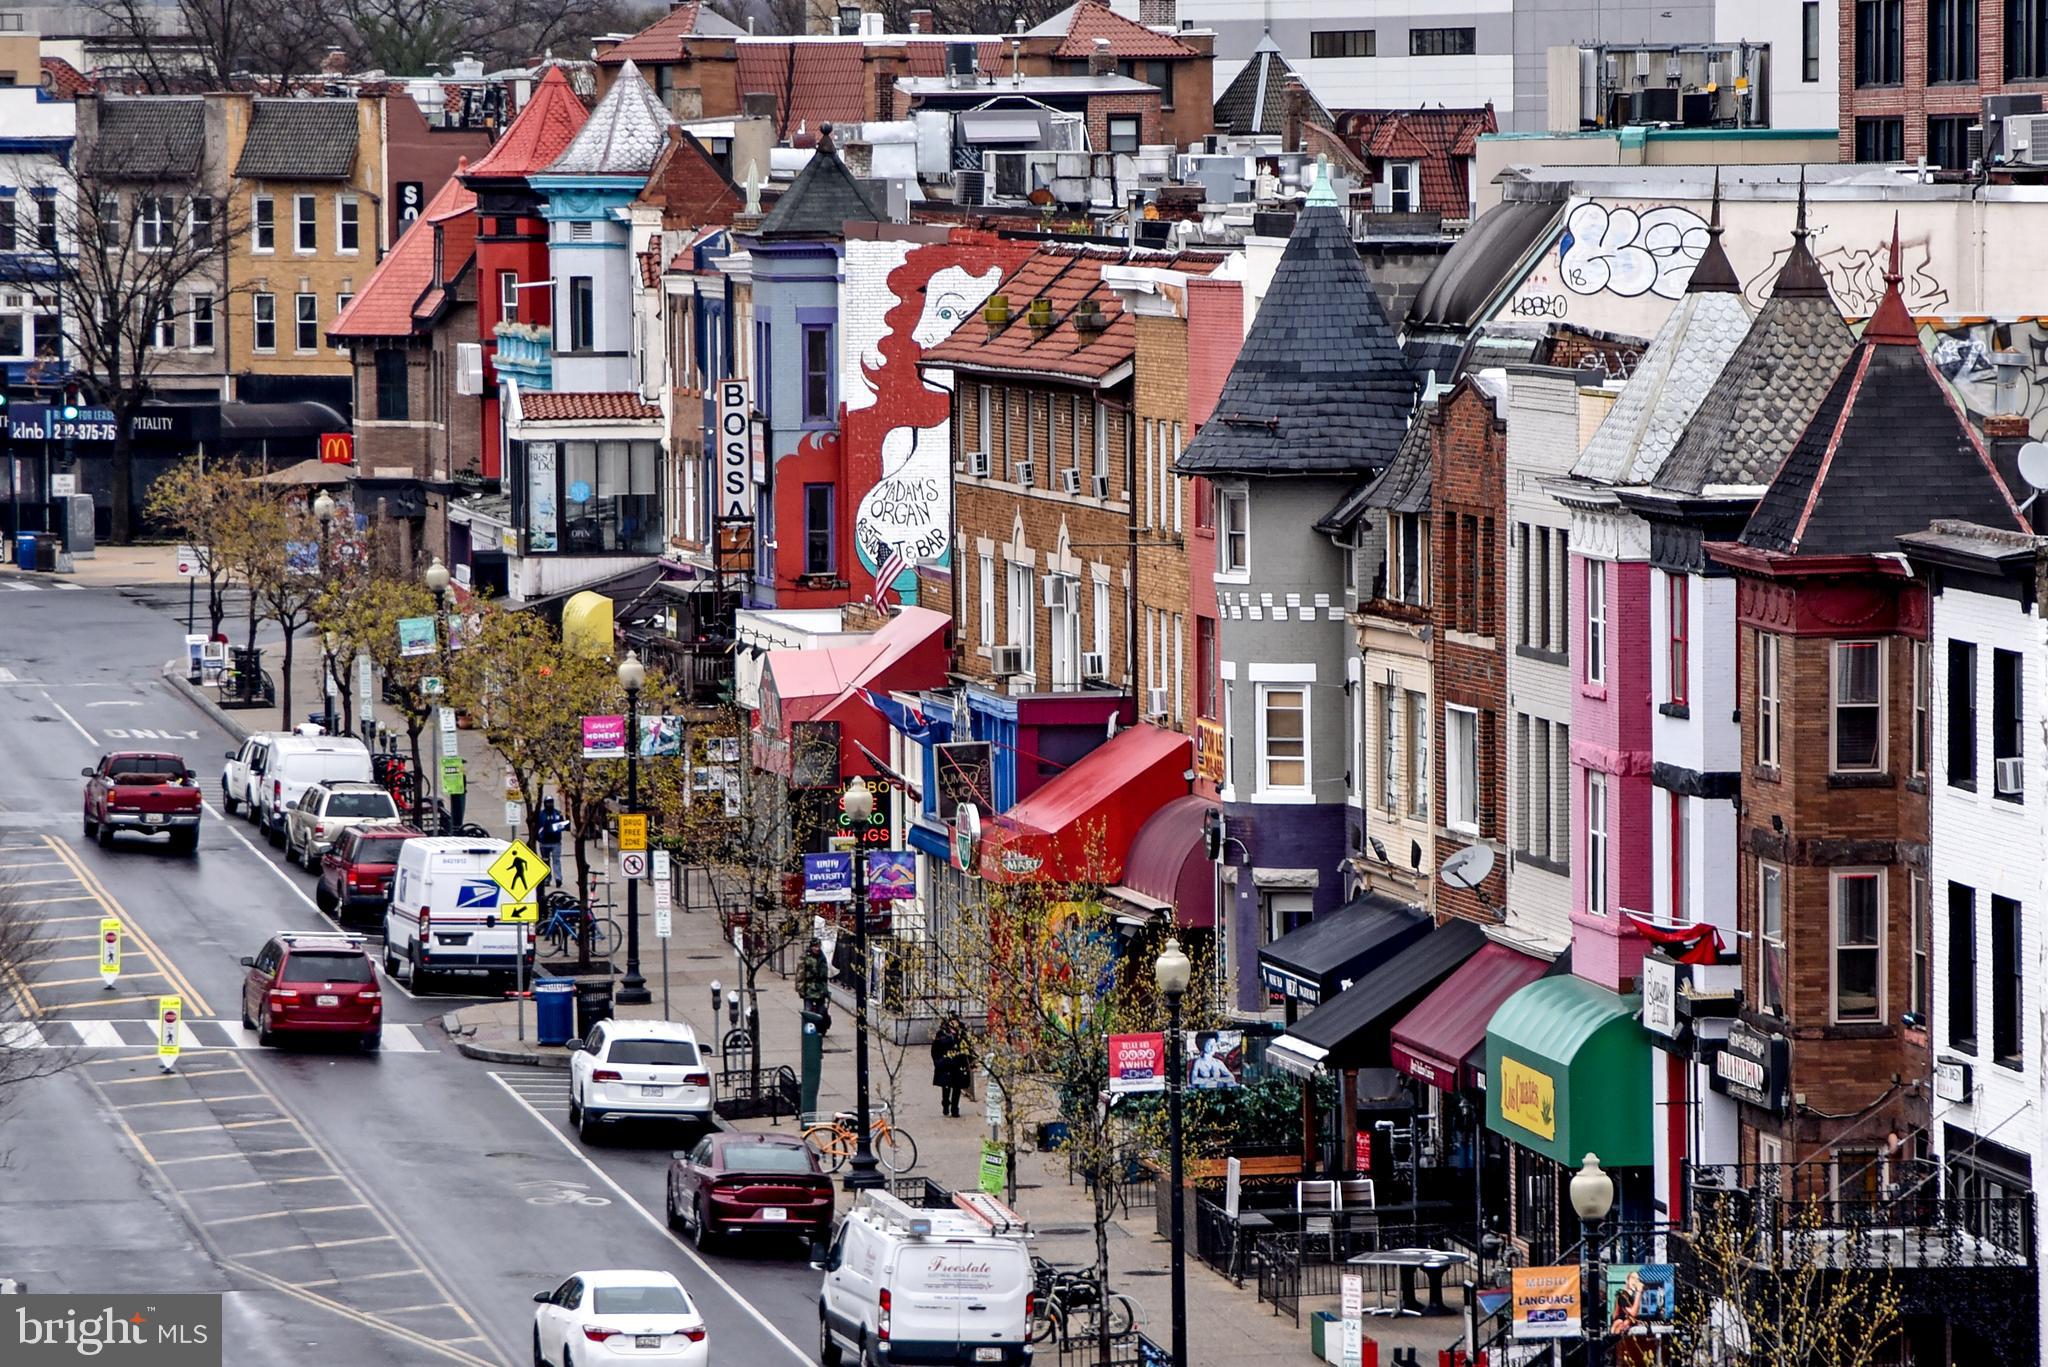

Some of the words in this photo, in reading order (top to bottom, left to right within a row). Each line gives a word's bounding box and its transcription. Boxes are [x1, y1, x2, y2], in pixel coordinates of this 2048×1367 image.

[724, 384, 745, 516] BOSSA
[873, 478, 939, 502] MADAM'S
[871, 500, 931, 526] ORGAN
[916, 528, 946, 557] BAR
[103, 729, 200, 739] ONLY
[1120, 1060, 1154, 1068] AWHILE
[928, 1256, 991, 1273] Freestate
[1518, 1295, 1574, 1306] LANGUAGE
